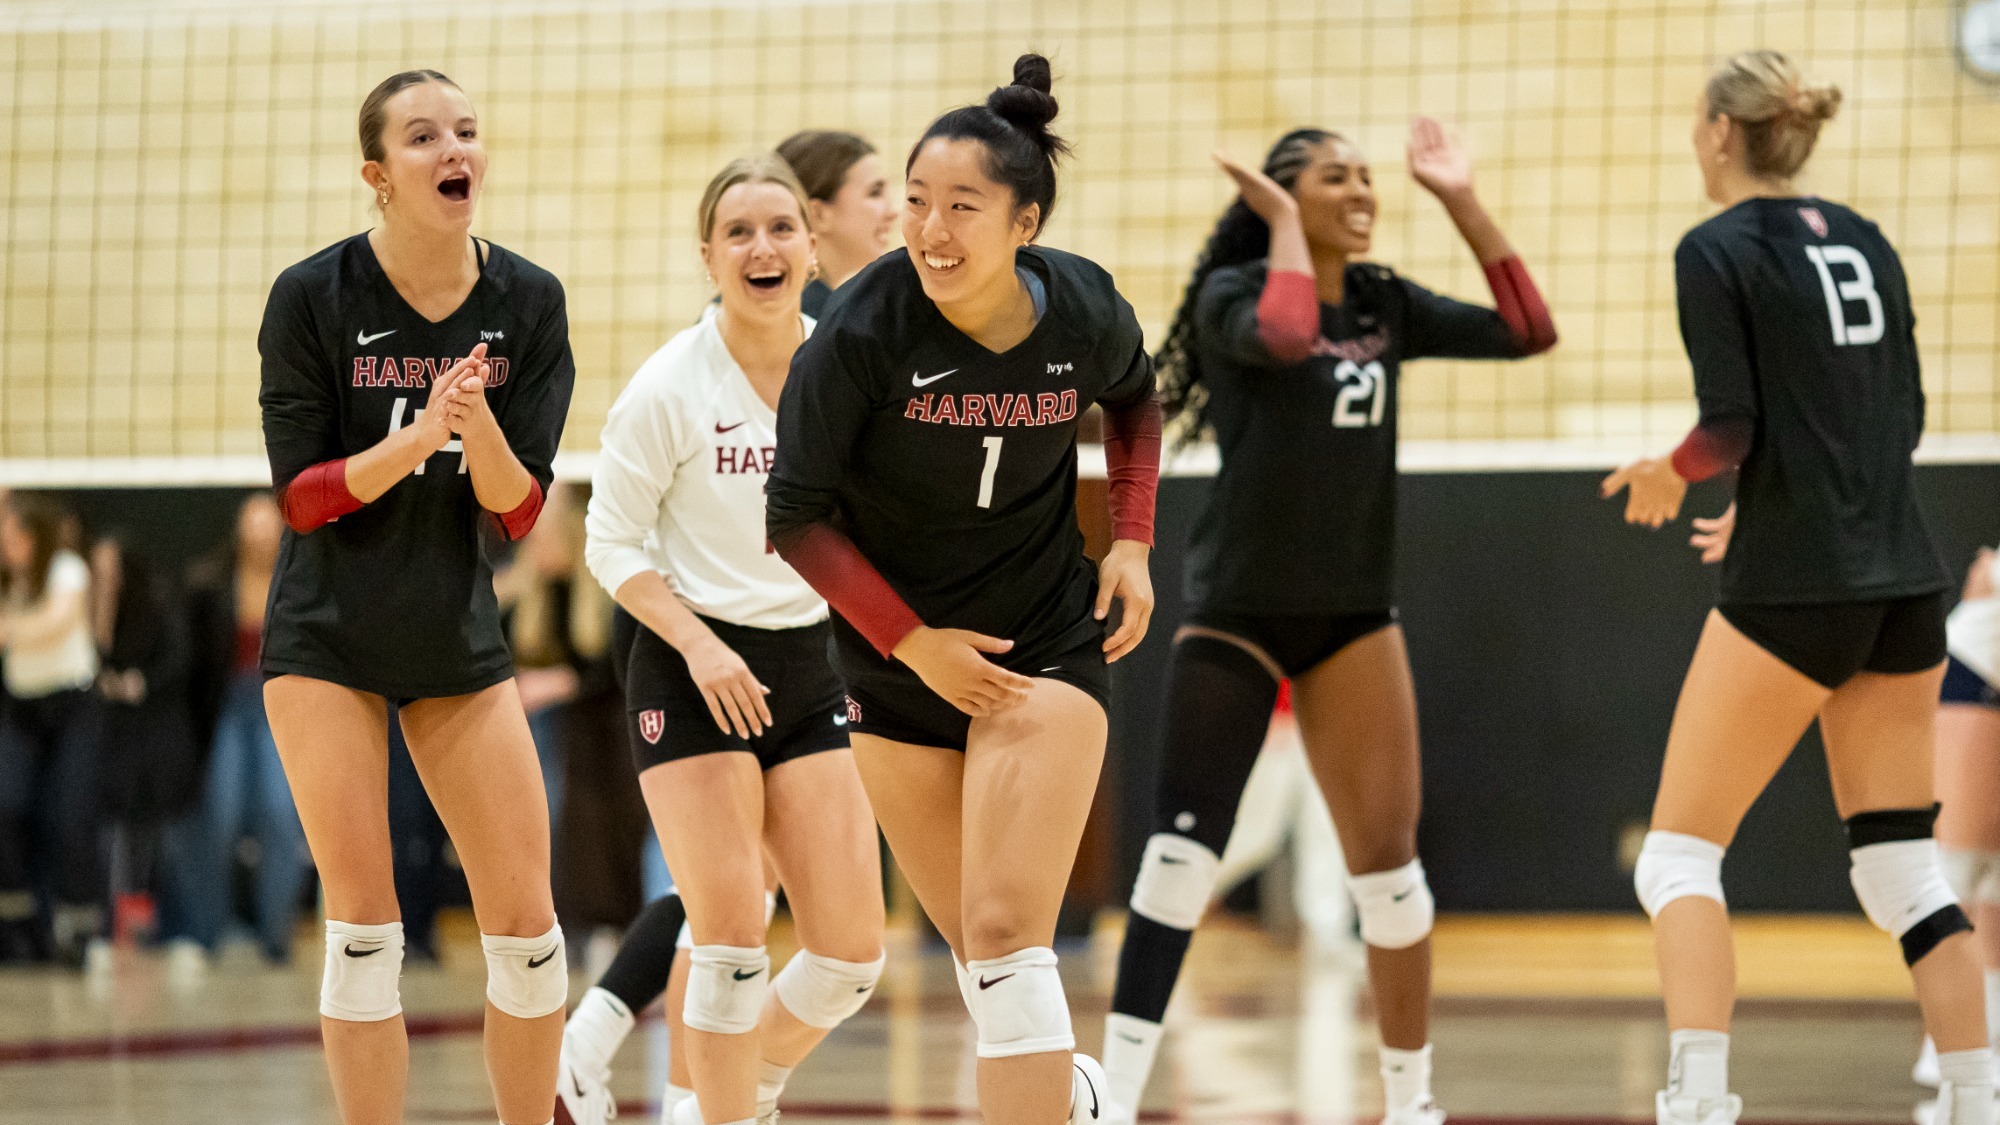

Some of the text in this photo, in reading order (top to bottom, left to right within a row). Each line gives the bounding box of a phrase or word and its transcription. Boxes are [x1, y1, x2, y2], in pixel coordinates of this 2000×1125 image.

[1804, 244, 1885, 346] 13
[352, 356, 509, 388] HARVD
[1331, 360, 1387, 428] 21
[904, 388, 1077, 426] HARVARD
[977, 436, 1003, 508] 1
